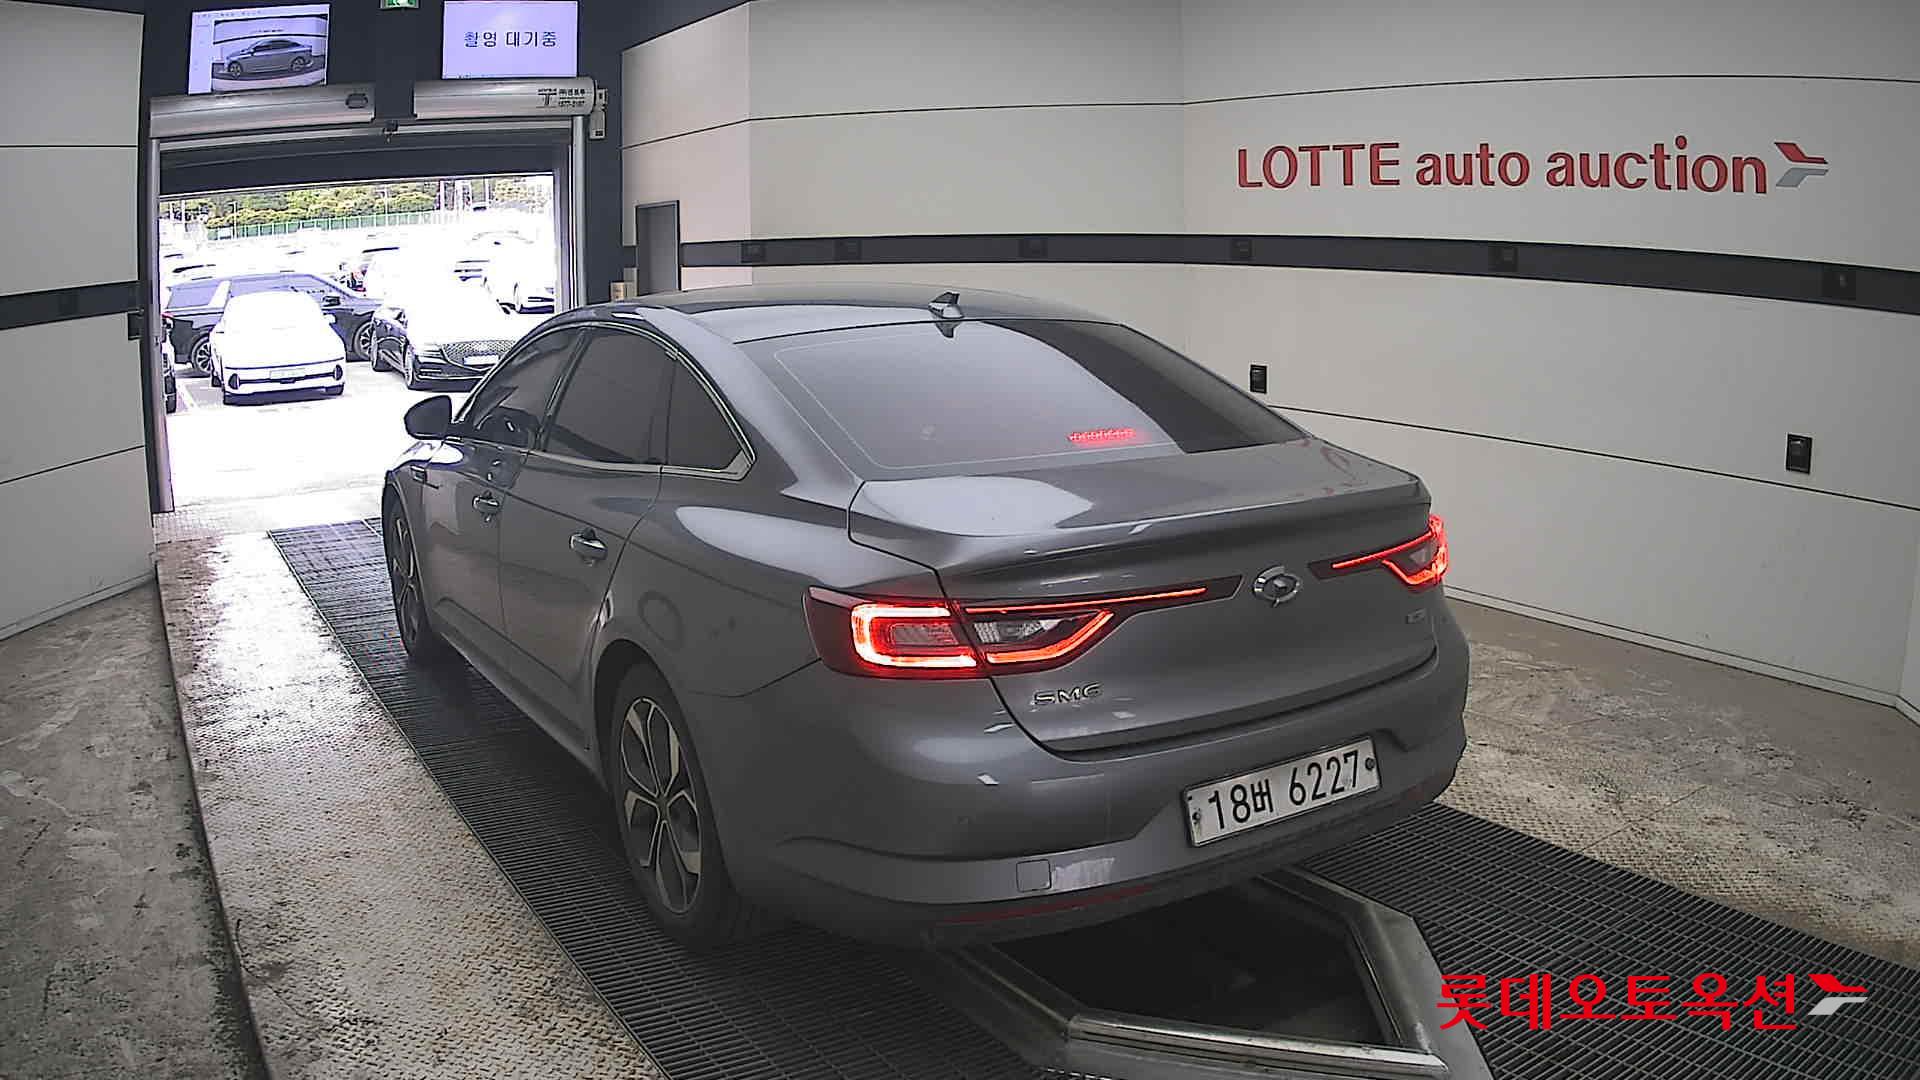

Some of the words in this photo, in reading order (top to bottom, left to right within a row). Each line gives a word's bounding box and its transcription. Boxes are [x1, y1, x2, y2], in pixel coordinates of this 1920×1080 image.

[1238, 143, 1399, 188] LOTTE
[1416, 143, 1530, 188] auto
[1546, 136, 1767, 194] auction
[1289, 750, 1358, 806] 6227
